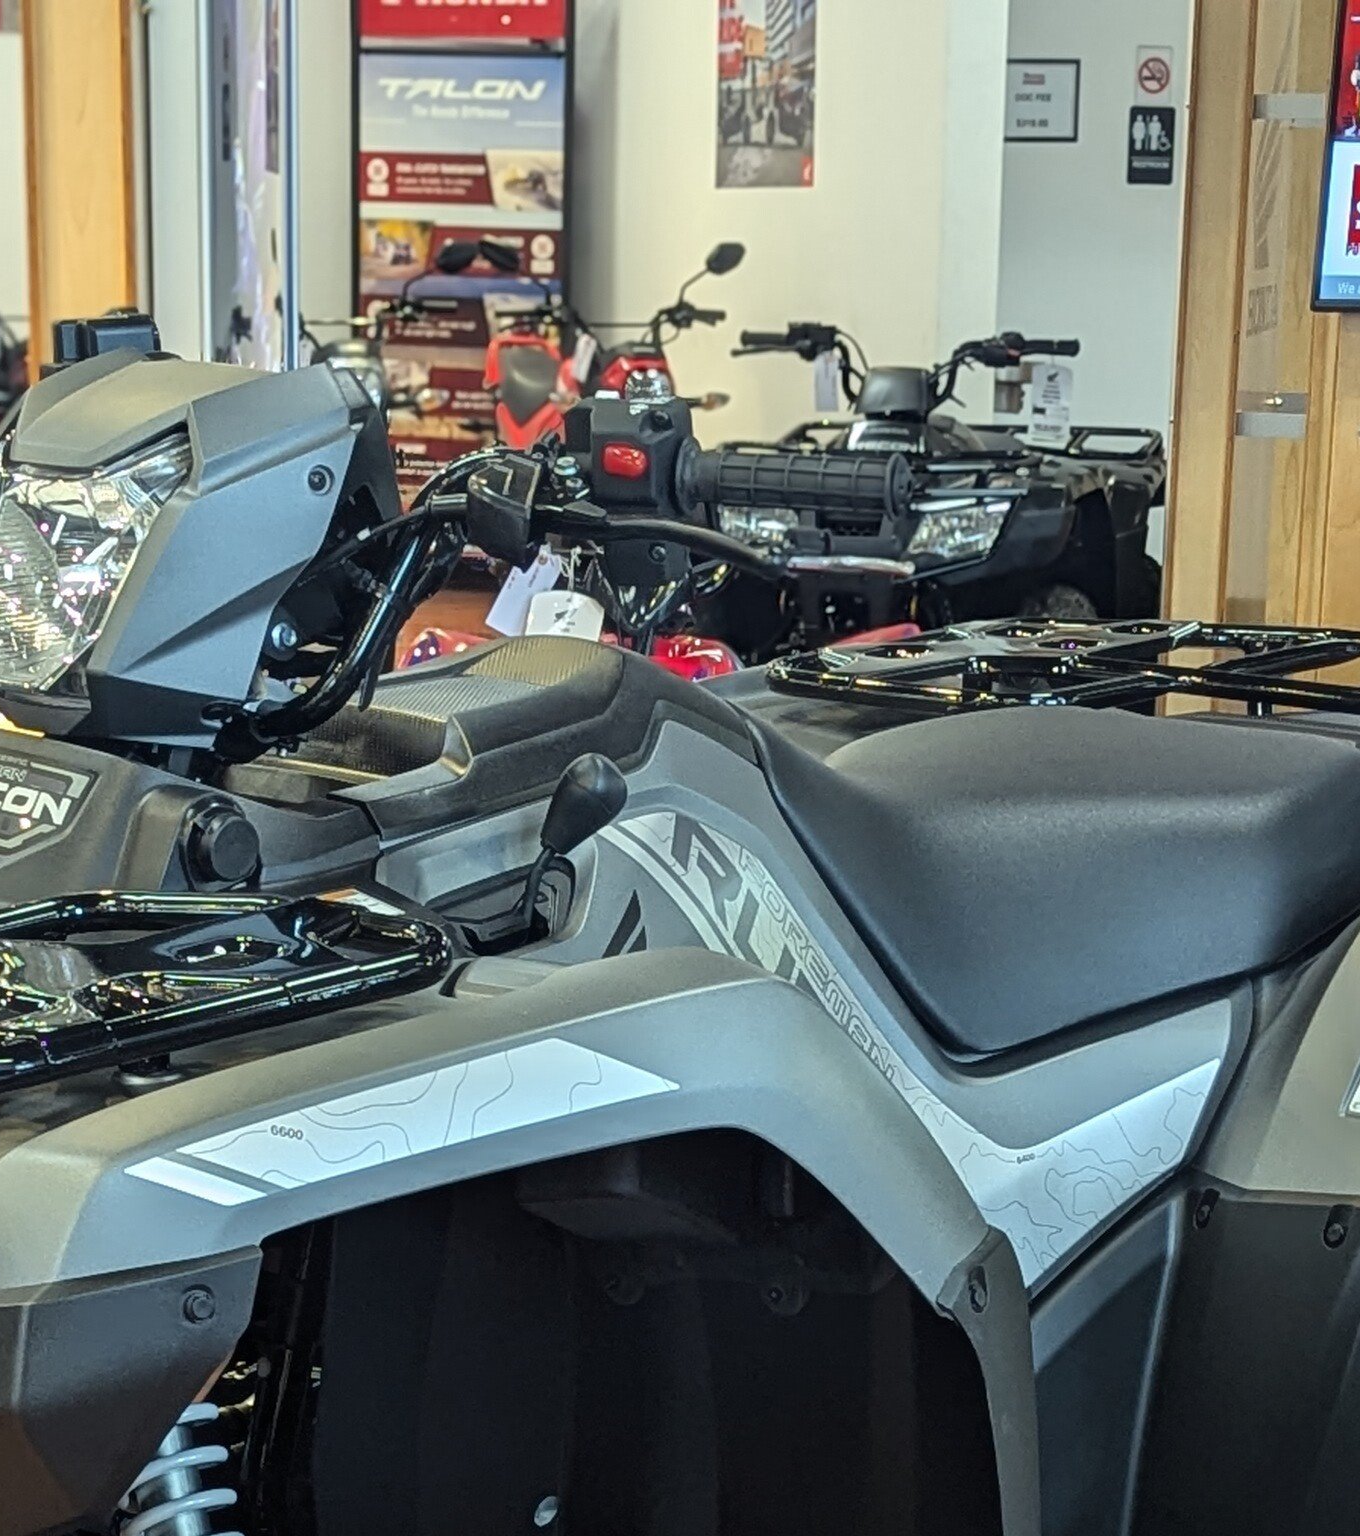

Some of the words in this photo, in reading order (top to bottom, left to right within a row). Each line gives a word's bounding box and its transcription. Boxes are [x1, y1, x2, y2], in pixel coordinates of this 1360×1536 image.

[378, 78, 547, 100] TALON
[1338, 282, 1355, 295] We
[739, 846, 896, 1083] FOREMAN
[269, 1123, 304, 1141] 6600
